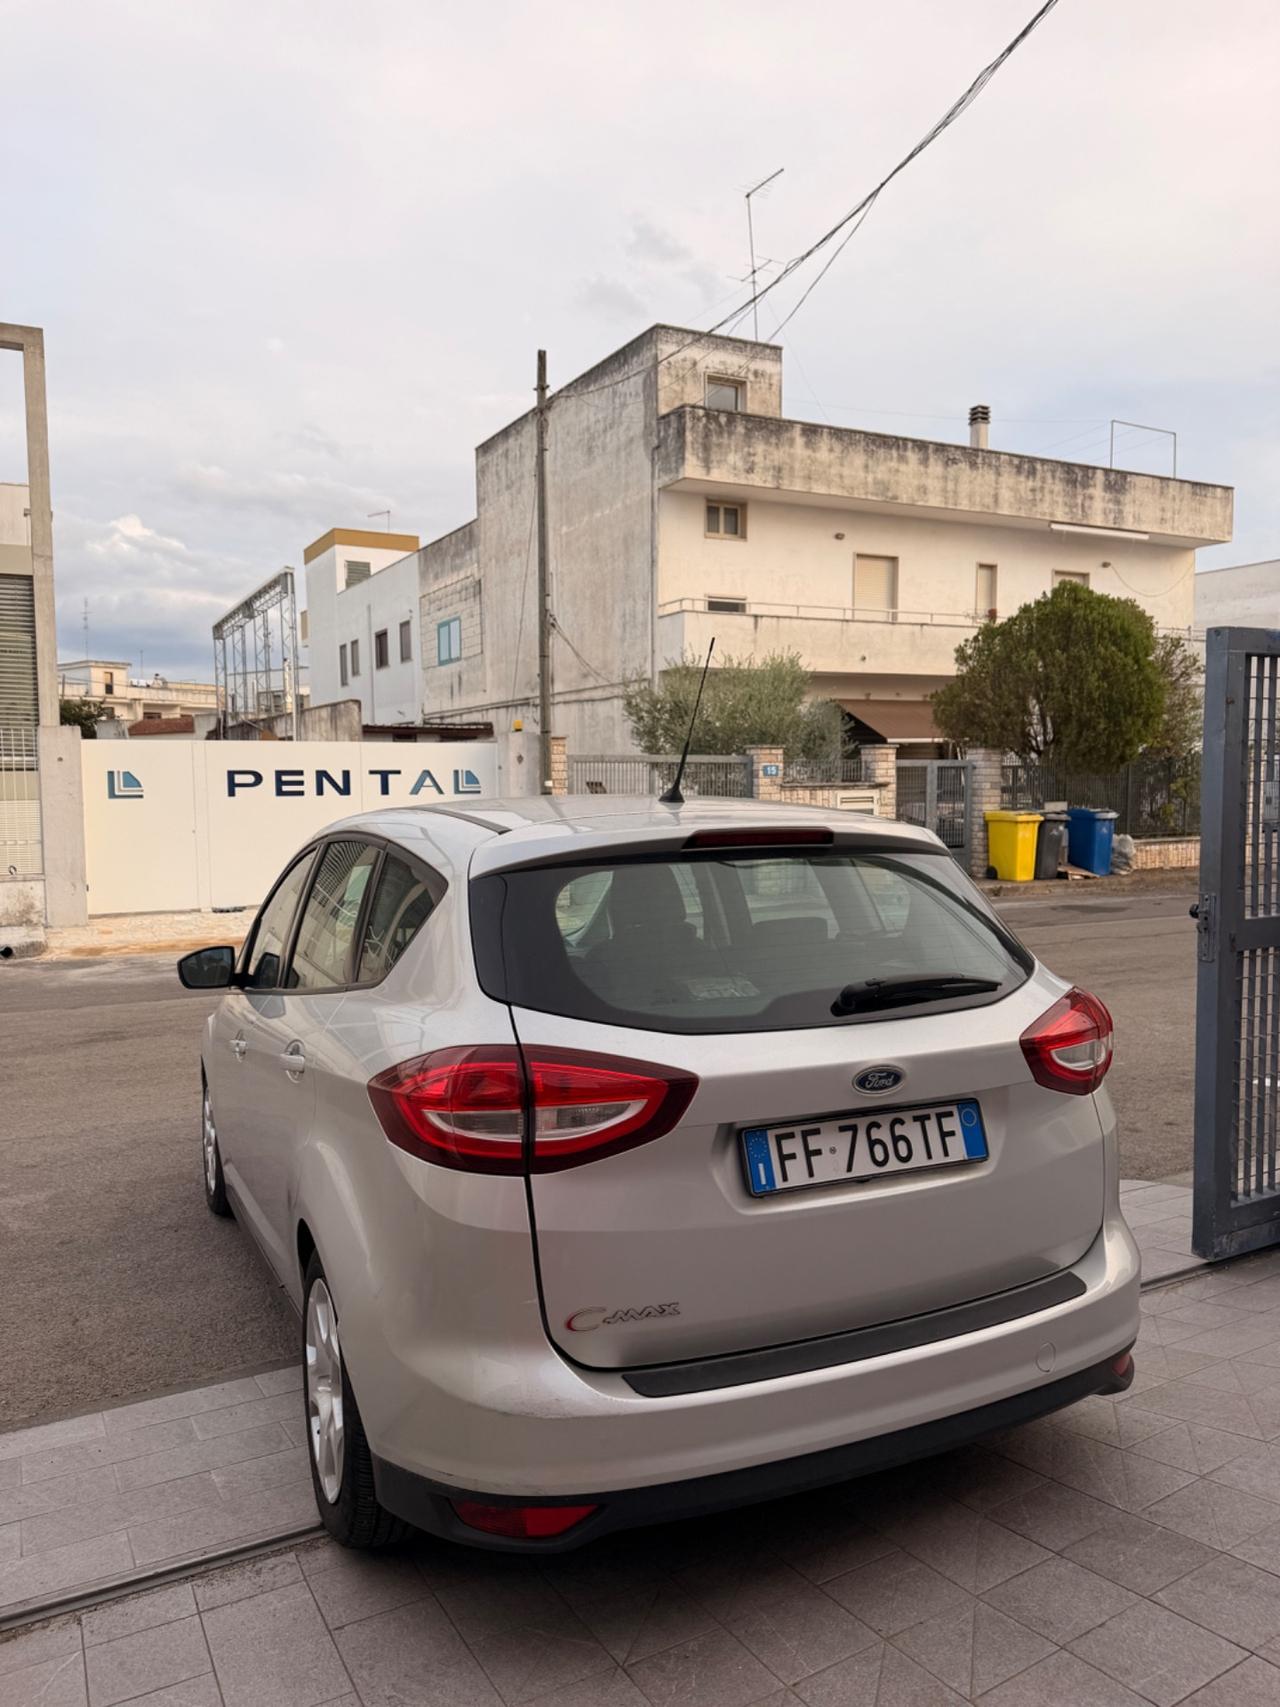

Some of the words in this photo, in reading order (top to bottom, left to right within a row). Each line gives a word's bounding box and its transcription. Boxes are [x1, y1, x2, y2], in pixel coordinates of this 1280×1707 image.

[227, 769, 482, 797] PENTAL
[865, 1072, 895, 1089] Ford
[758, 1163, 767, 1185] I
